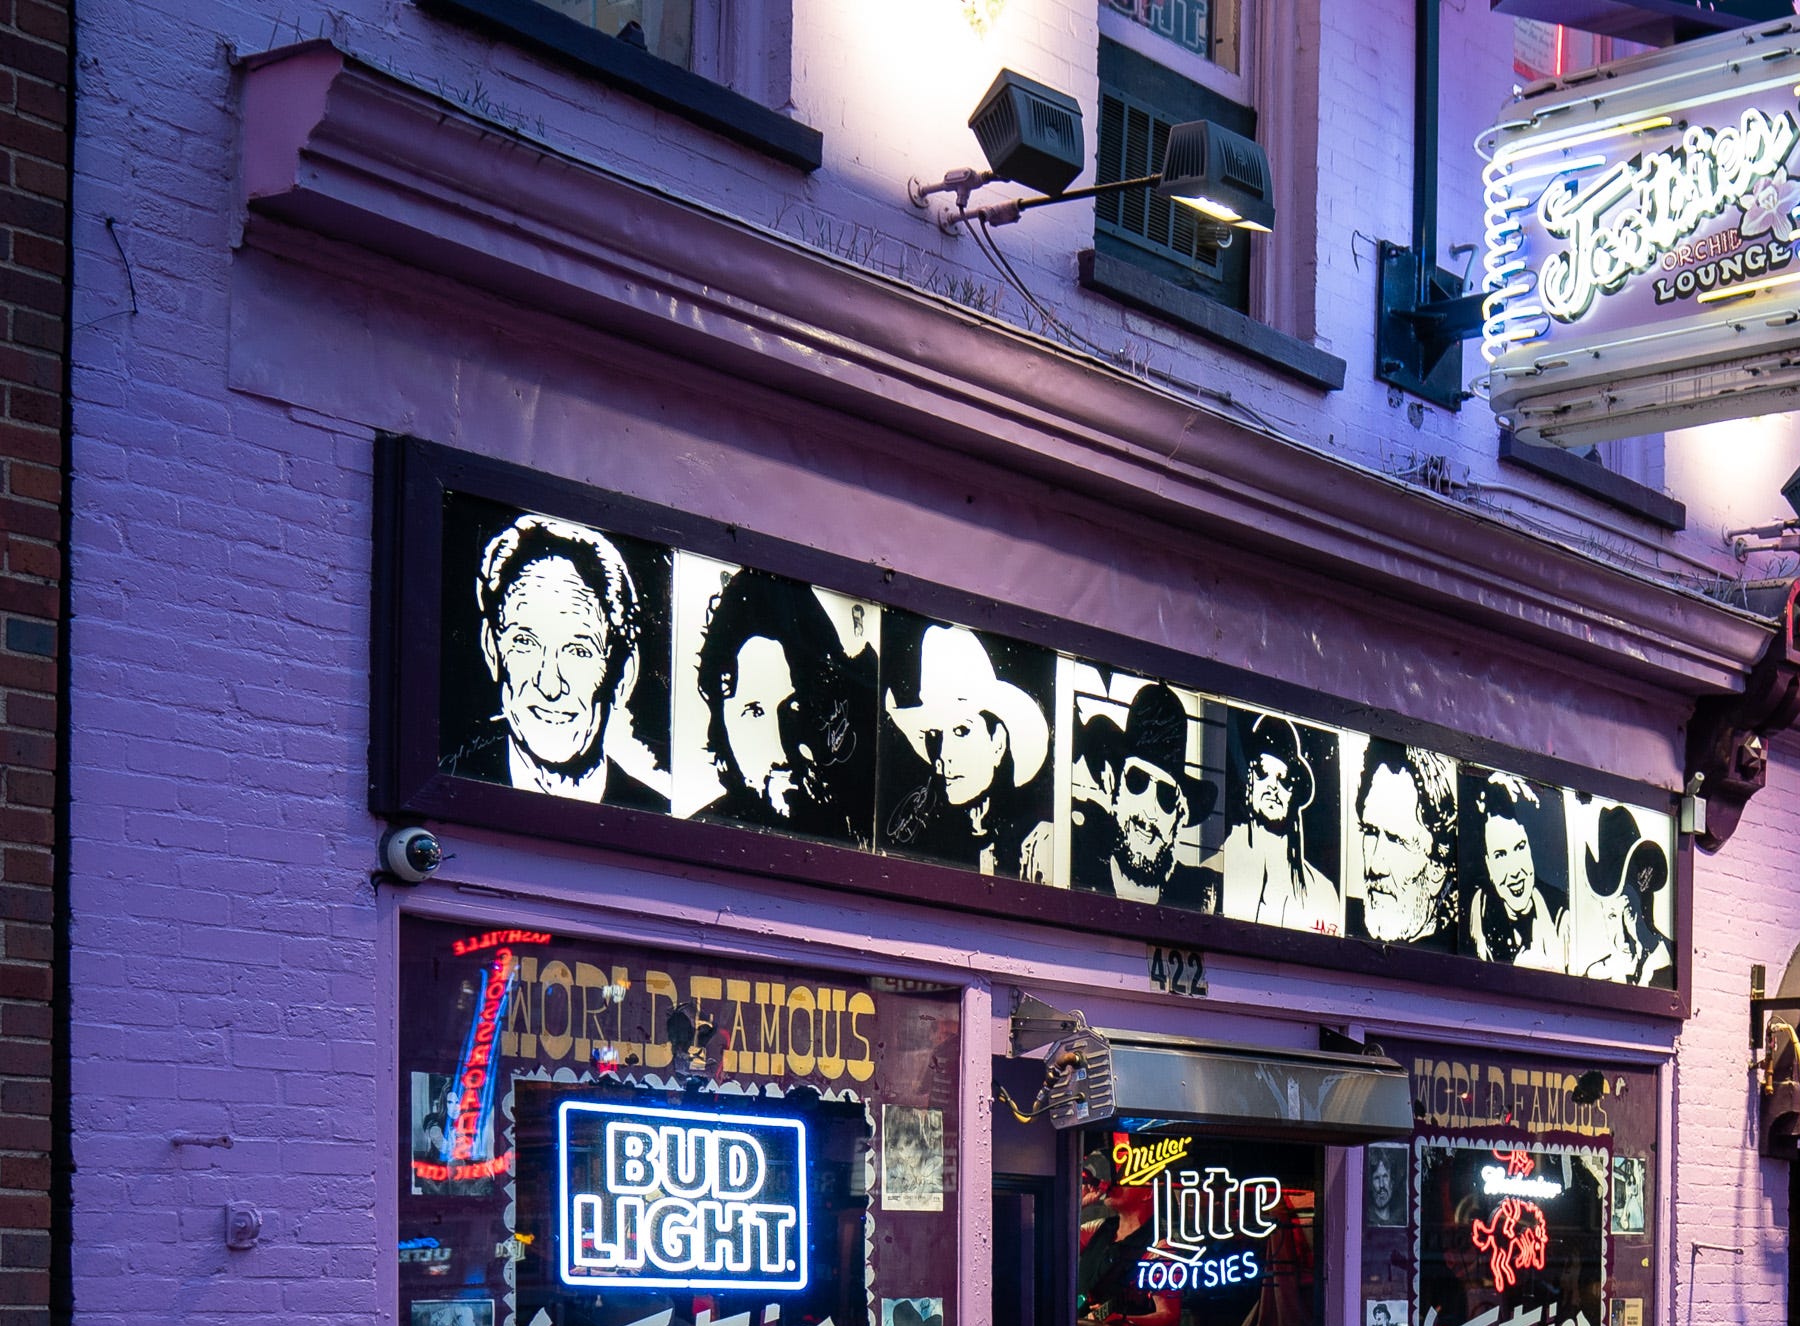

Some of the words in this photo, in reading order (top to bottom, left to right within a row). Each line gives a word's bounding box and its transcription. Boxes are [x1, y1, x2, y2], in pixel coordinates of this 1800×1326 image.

[1656, 243, 1793, 303] LOUNGE
[1661, 227, 1743, 271] ORCHID
[1150, 946, 1208, 995] 422
[501, 955, 678, 1069] WORLD
[688, 976, 876, 1083] FAMOUS
[1414, 1057, 1506, 1129] WORLD
[1511, 1068, 1611, 1137] FAMOUS
[605, 1120, 766, 1201] BUD
[1112, 1135, 1192, 1184] Miller
[1147, 1166, 1281, 1262] Lite
[1136, 1250, 1259, 1291] TOOTSIES
